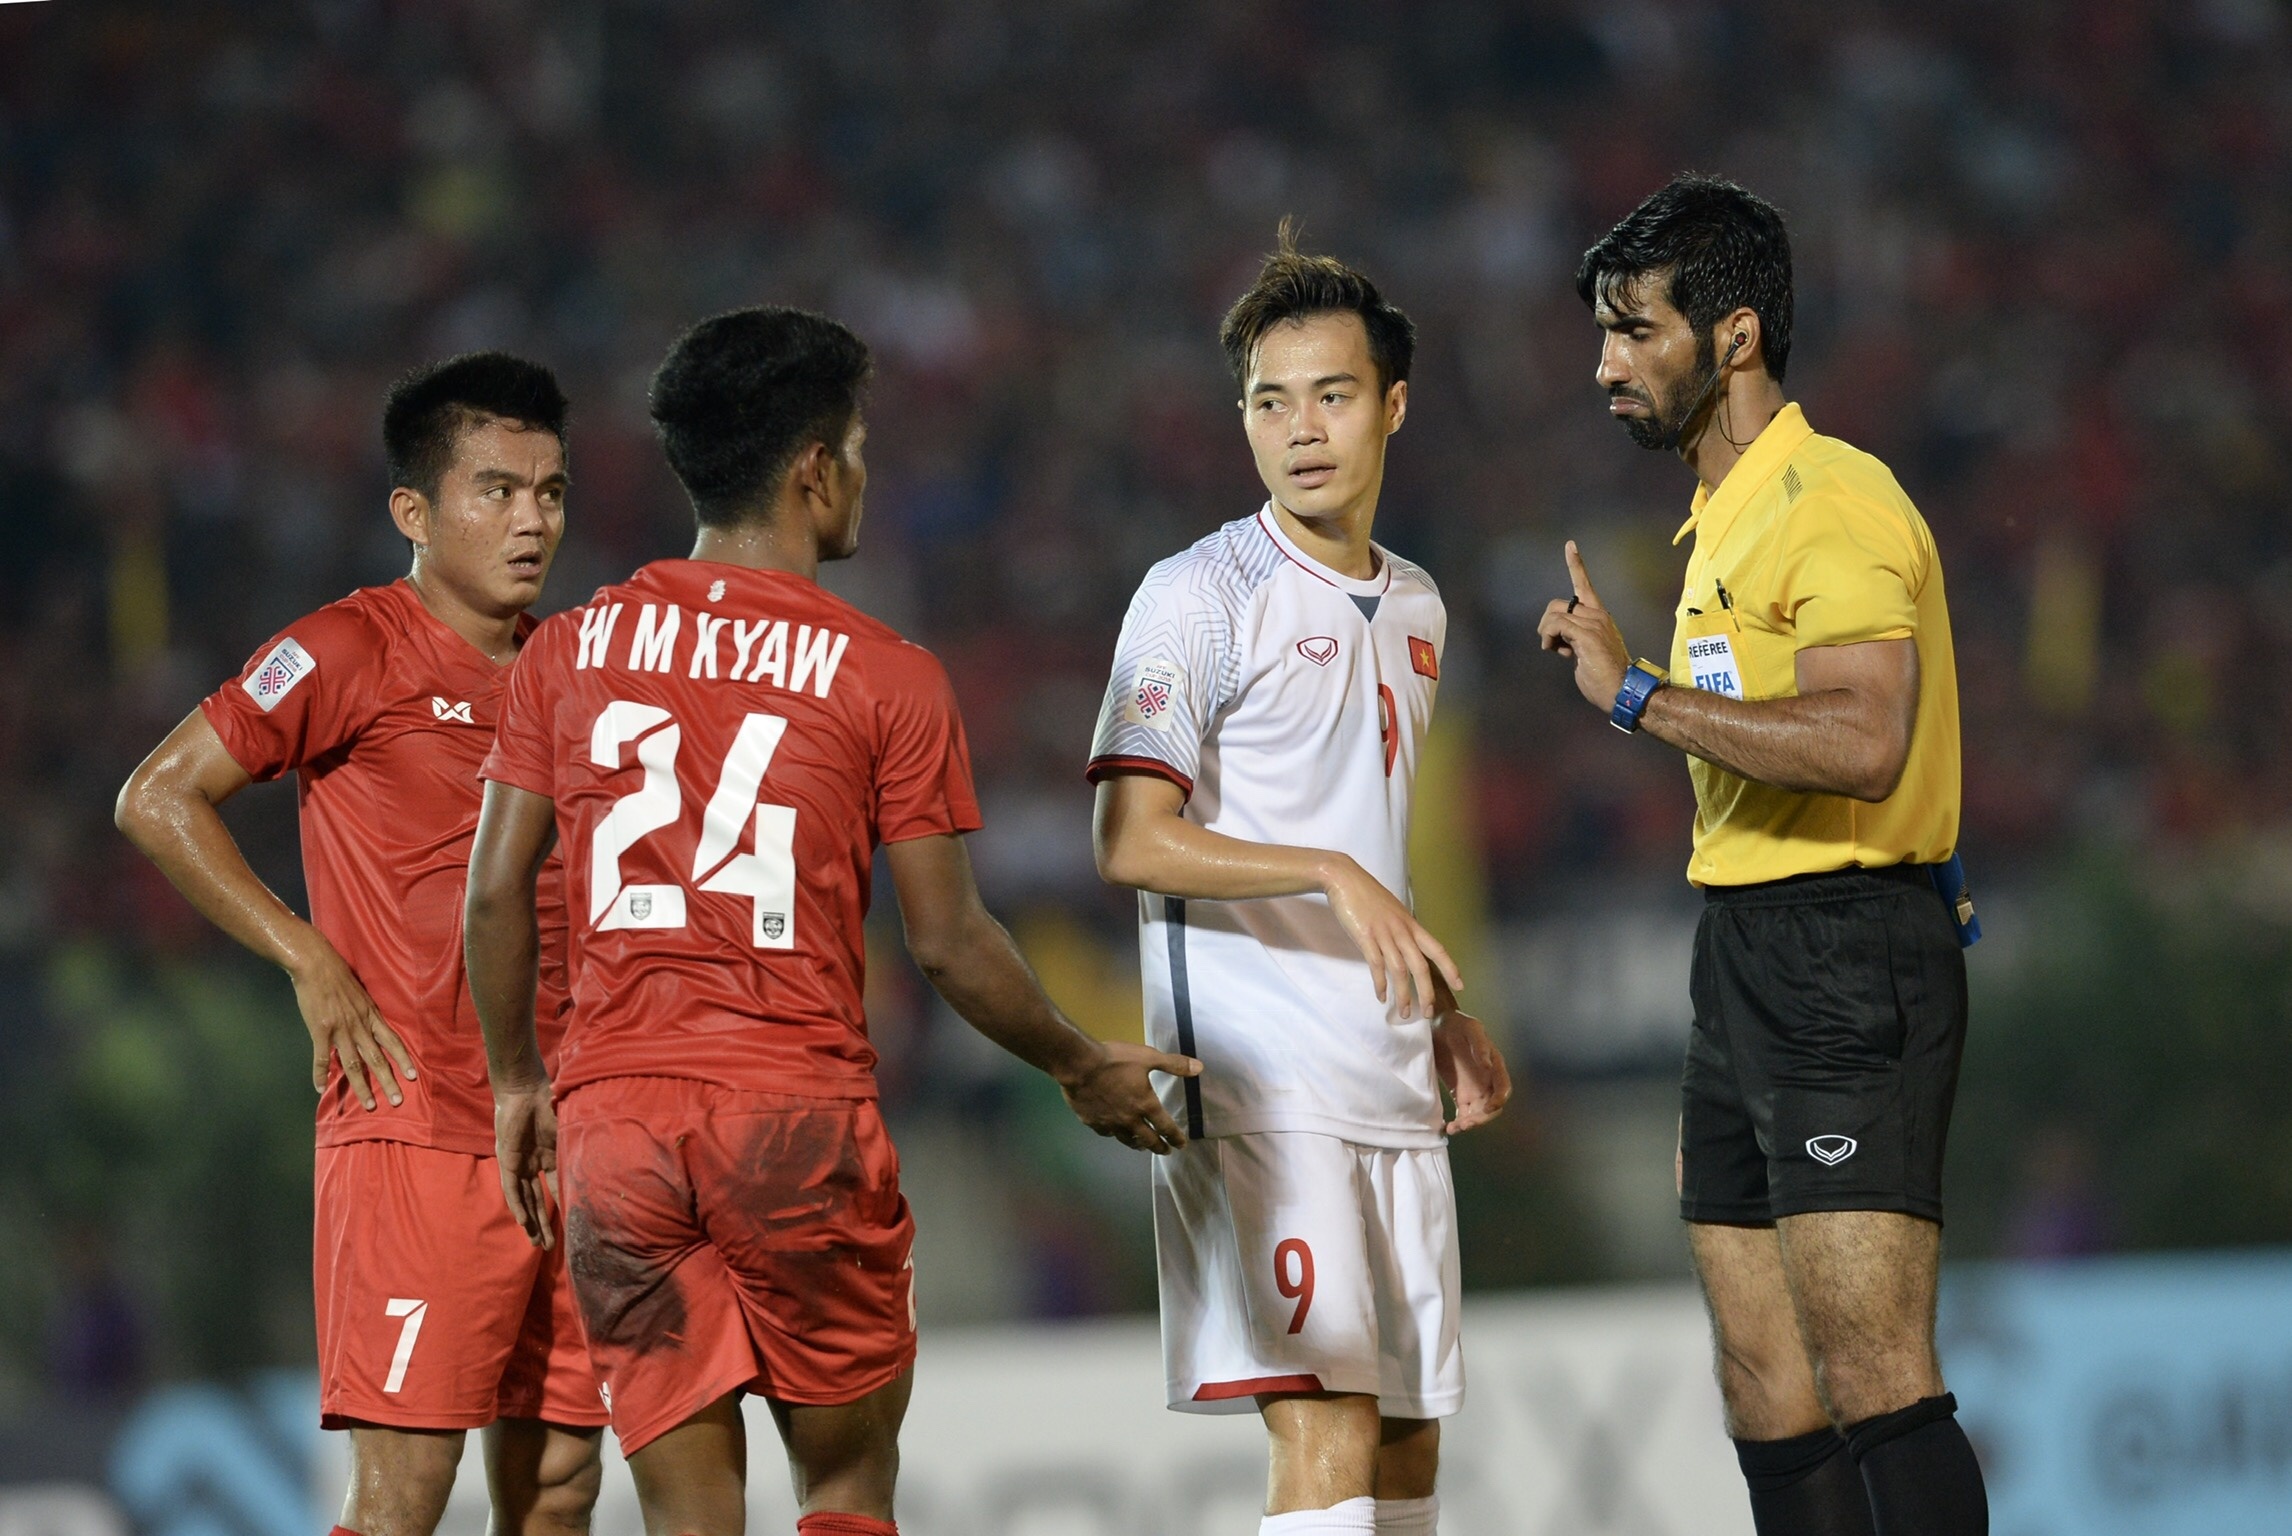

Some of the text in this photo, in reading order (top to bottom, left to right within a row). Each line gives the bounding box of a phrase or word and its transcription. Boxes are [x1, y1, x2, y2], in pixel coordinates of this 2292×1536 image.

[576, 602, 850, 699] W M KYAW
[1144, 666, 1176, 679] SUZUKI
[1688, 642, 1729, 658] REFEREE
[1695, 671, 1736, 693] FIFA
[589, 700, 798, 949] 24
[1274, 1238, 1316, 1335] 9
[383, 1298, 428, 1393] 7
